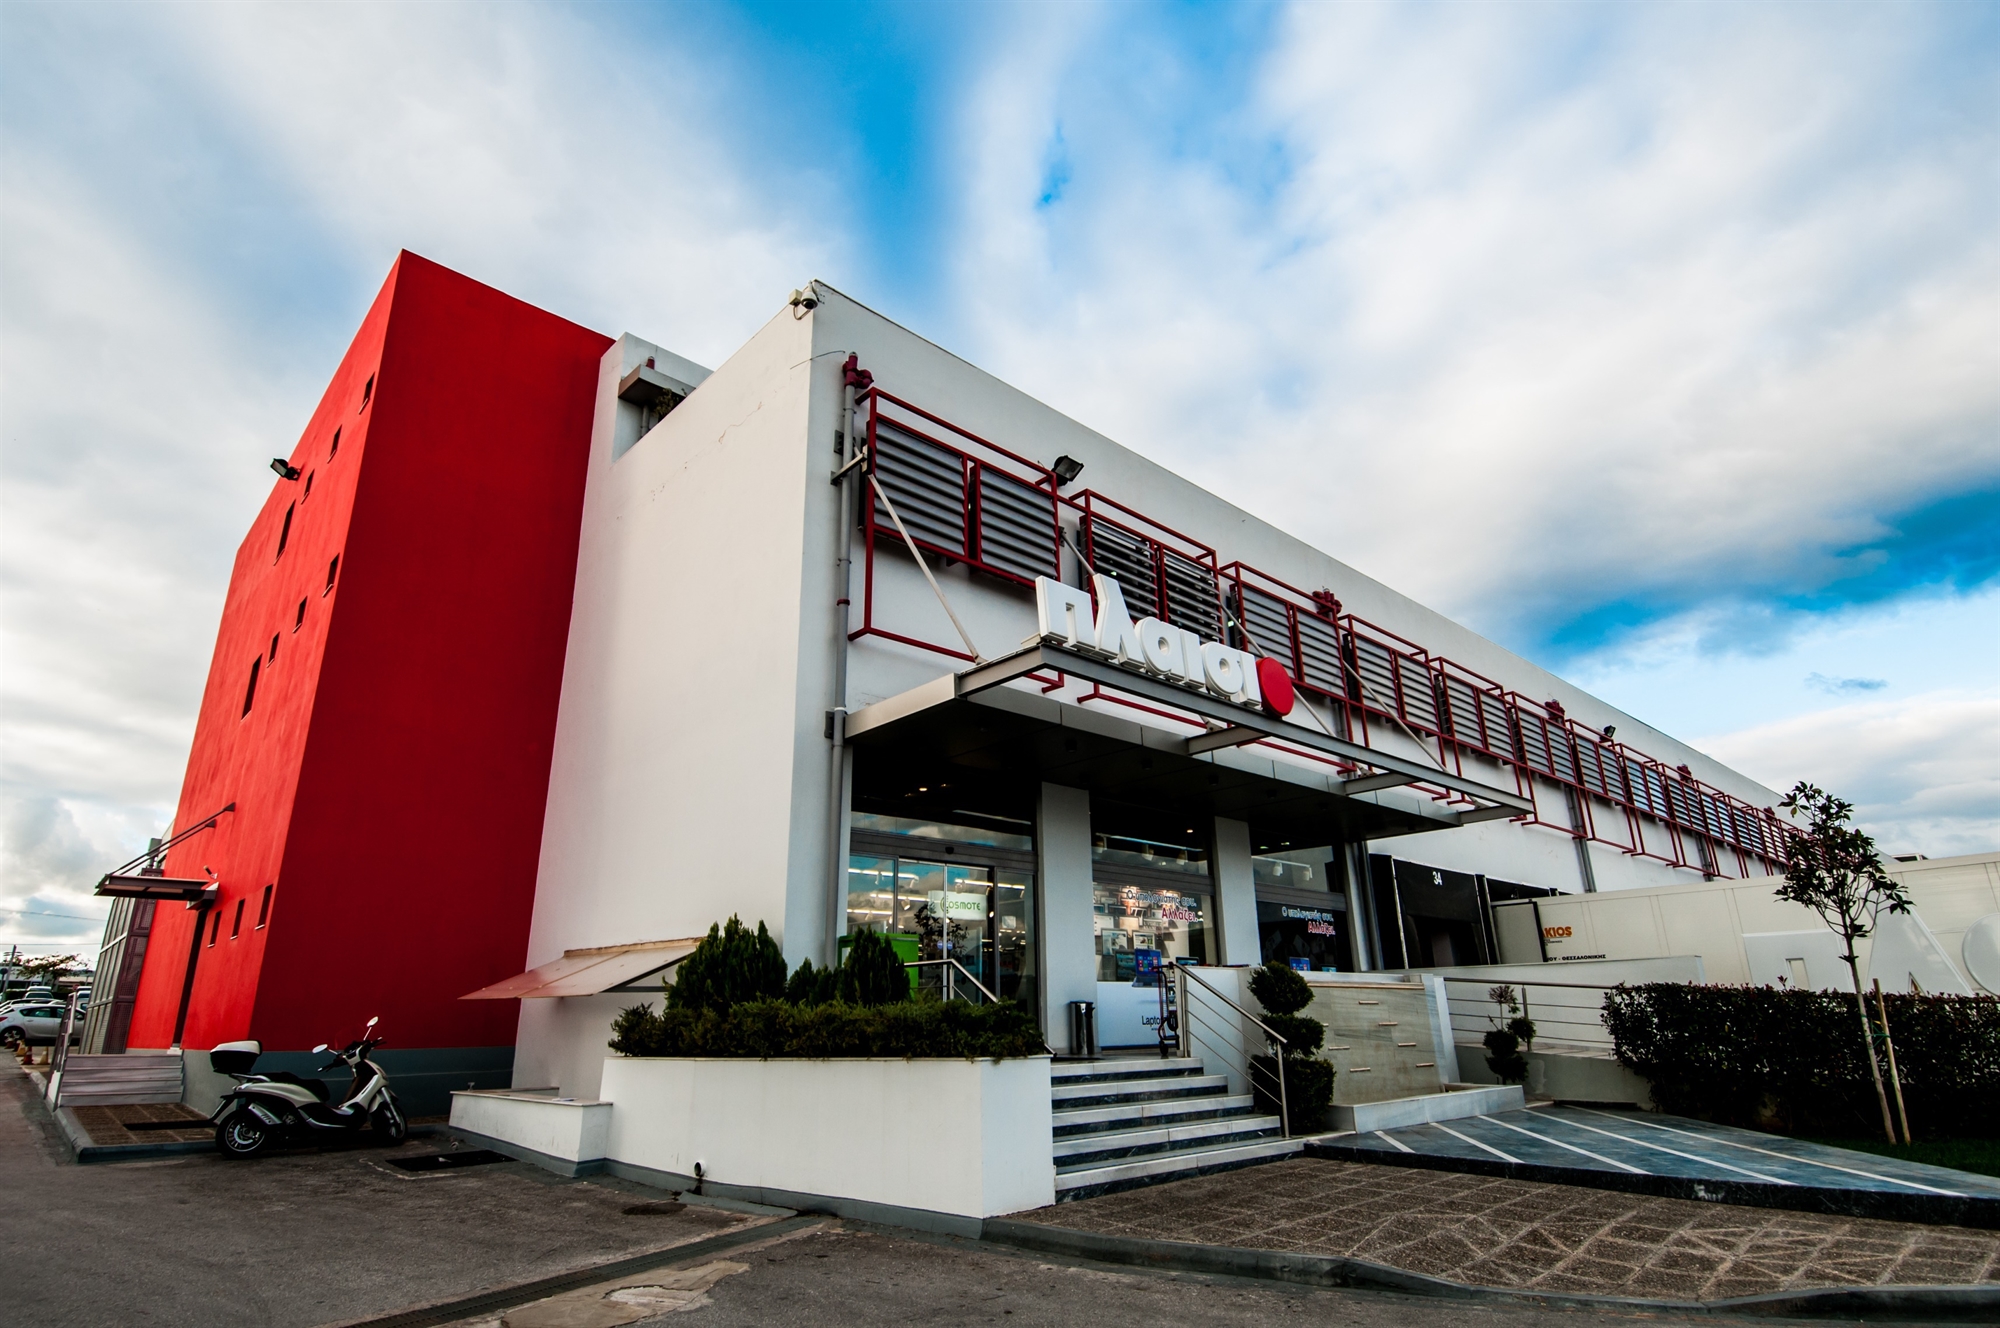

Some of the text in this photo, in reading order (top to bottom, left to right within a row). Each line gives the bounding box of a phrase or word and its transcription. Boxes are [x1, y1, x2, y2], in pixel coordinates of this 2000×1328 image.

[1432, 871, 1443, 885] 34
[1562, 953, 1606, 961] ΘΕΣΣΑΛΟΝΙΚΗΣ
[1141, 1015, 1161, 1027] Lapto
